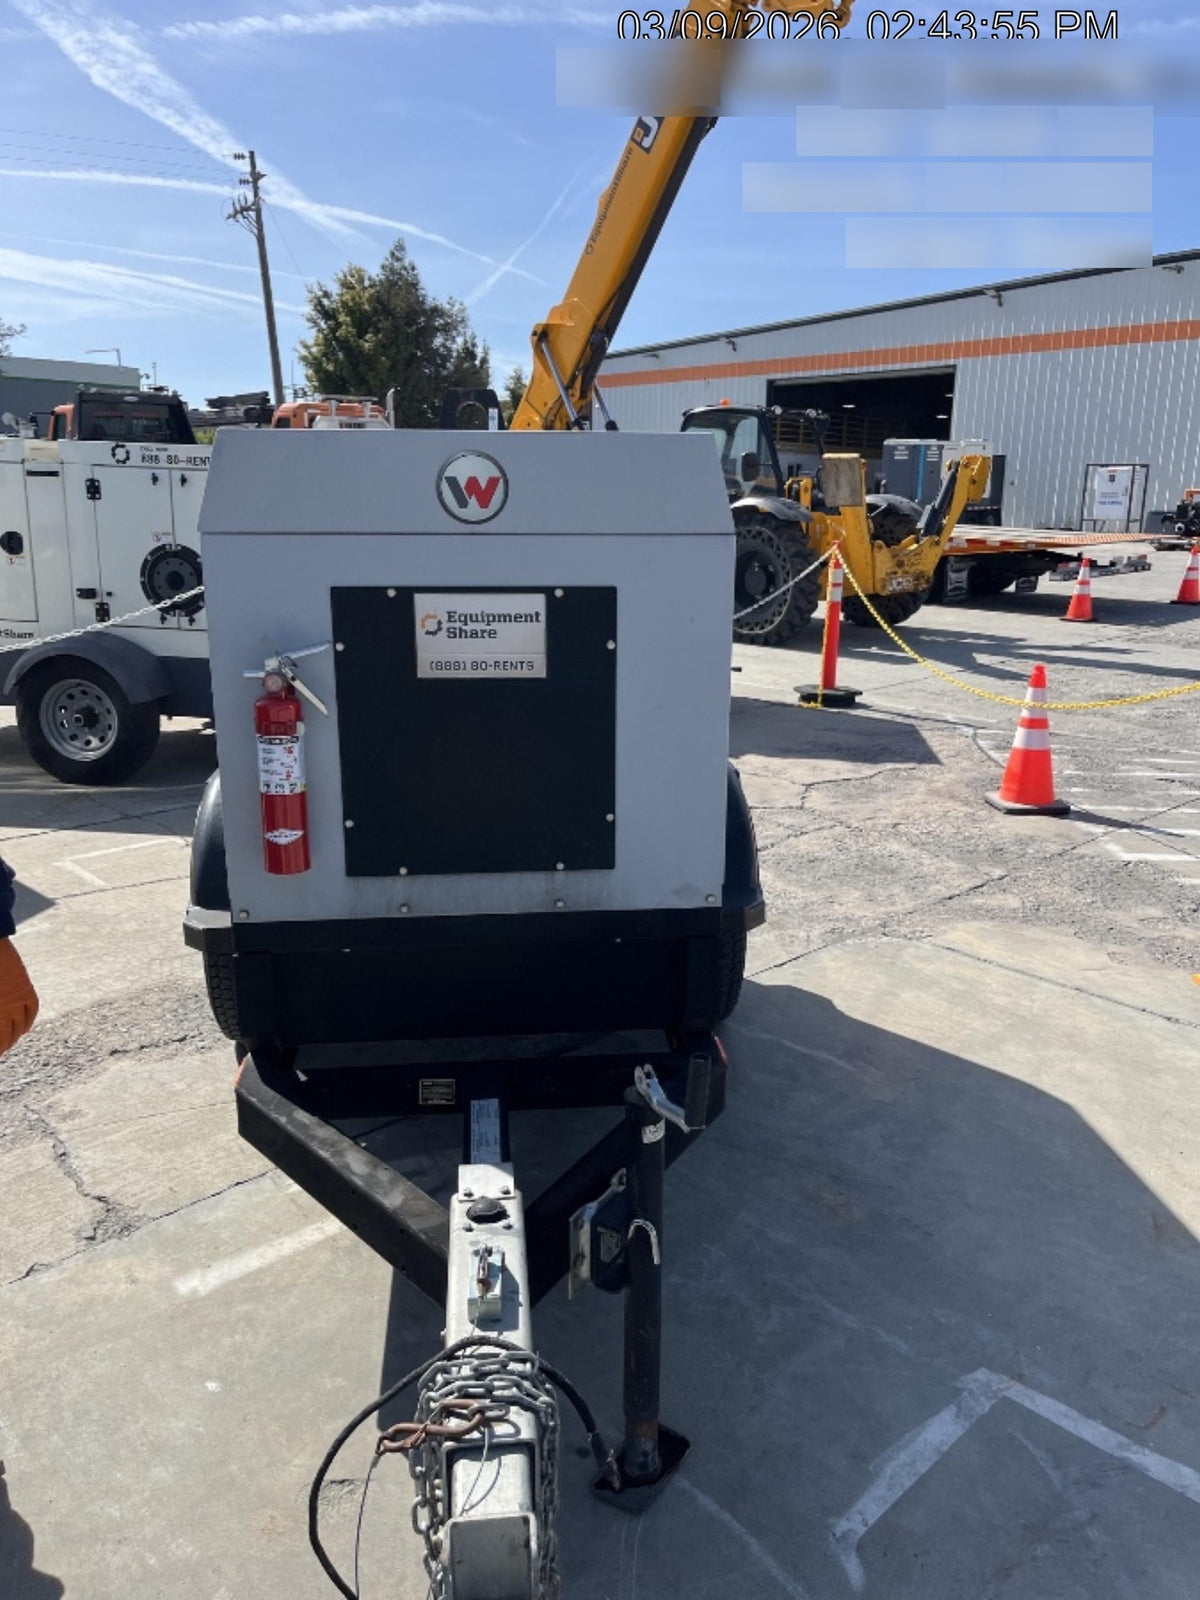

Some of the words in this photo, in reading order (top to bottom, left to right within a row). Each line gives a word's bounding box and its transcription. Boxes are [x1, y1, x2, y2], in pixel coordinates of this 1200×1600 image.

[446, 610, 541, 626] Equipment
[446, 626, 498, 639] Share
[429, 660, 467, 671] (888)
[470, 660, 535, 671] 80-RENTS
